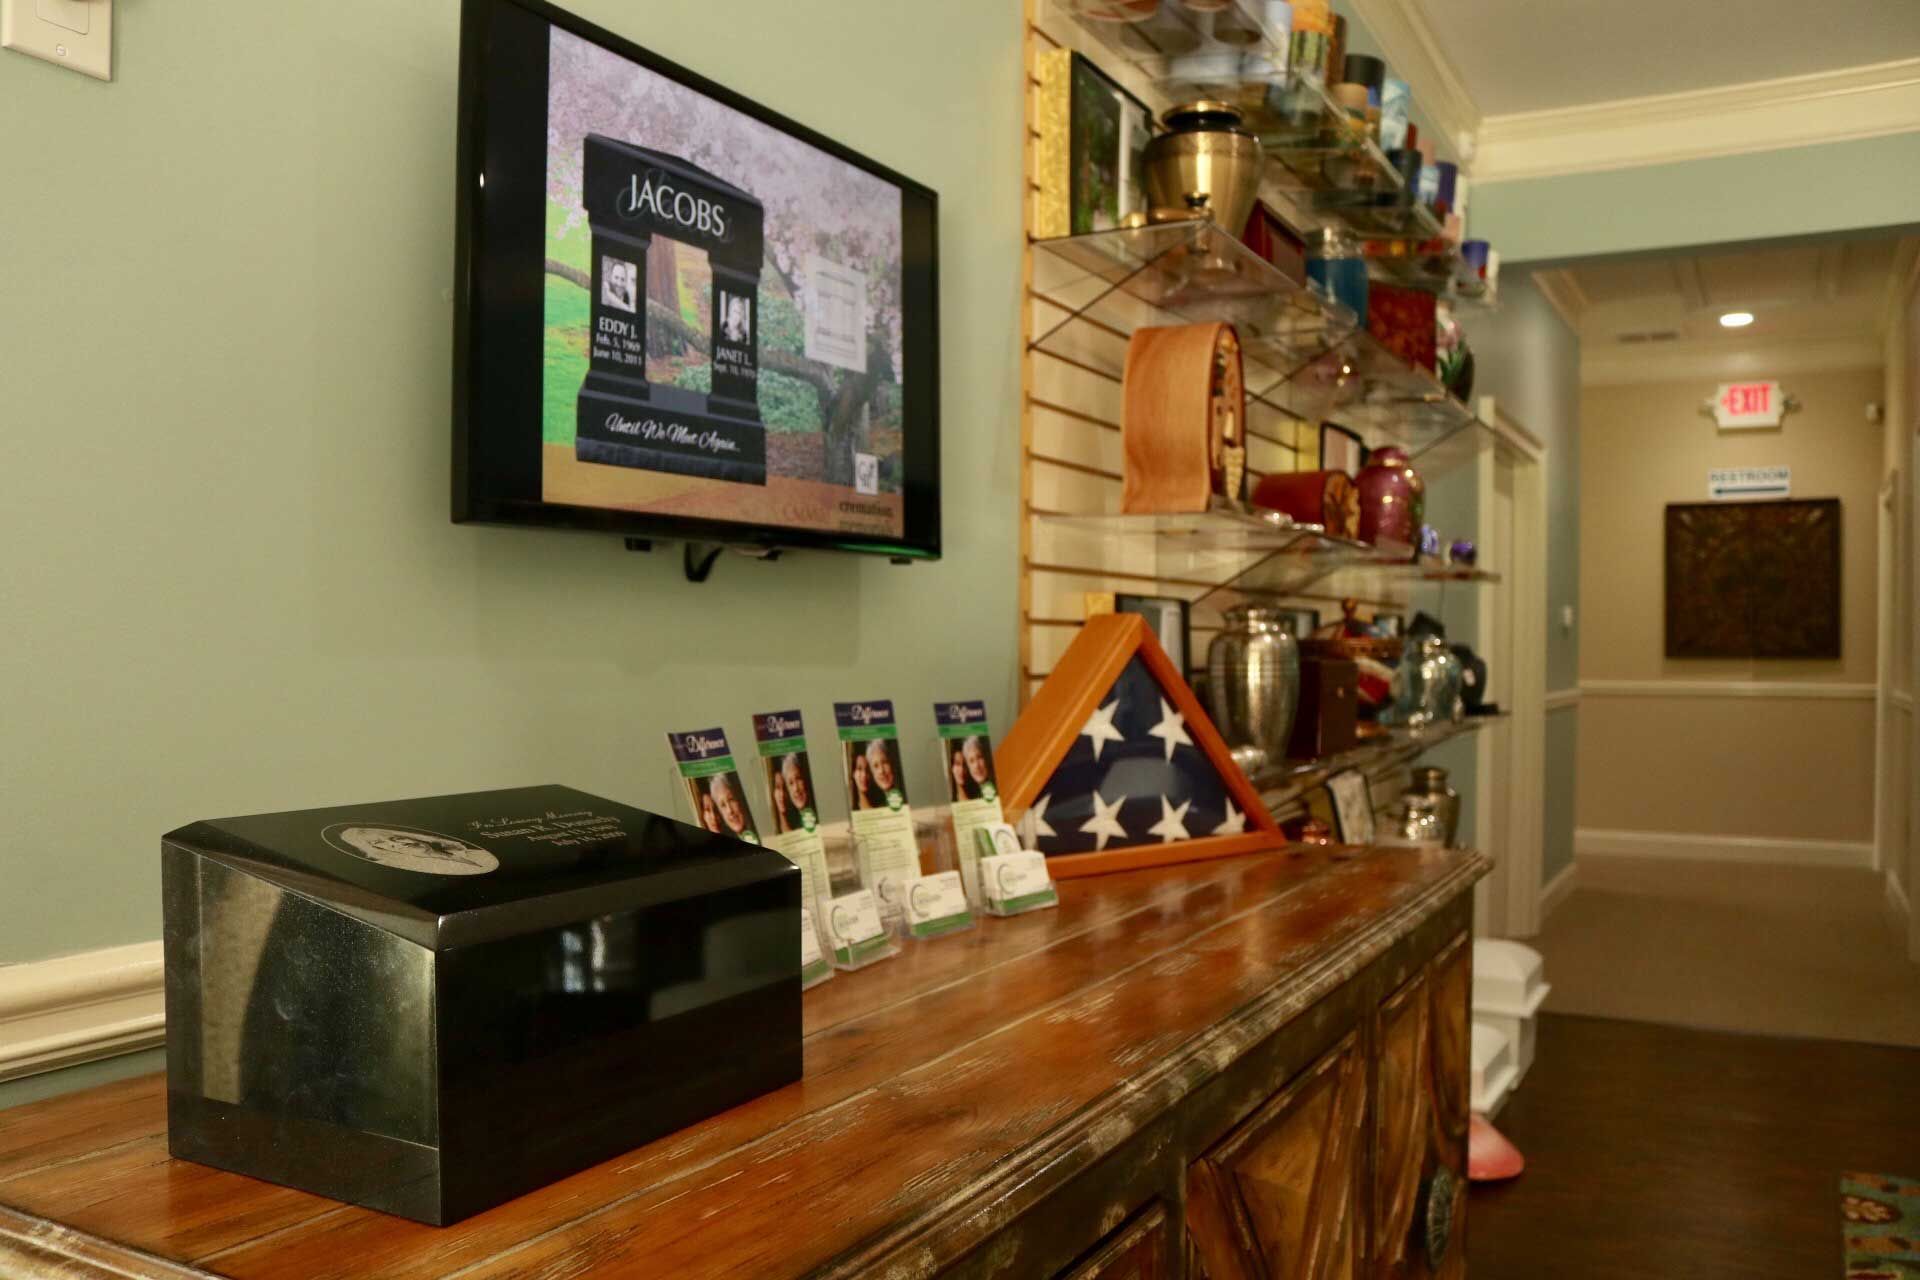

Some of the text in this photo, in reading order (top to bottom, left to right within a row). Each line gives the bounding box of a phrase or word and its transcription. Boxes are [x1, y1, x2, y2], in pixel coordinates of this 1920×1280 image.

[628, 174, 725, 236] JACOBS
[599, 316, 628, 337] EDDY
[716, 345, 742, 364] JANET
[1727, 383, 1771, 416] EXIT
